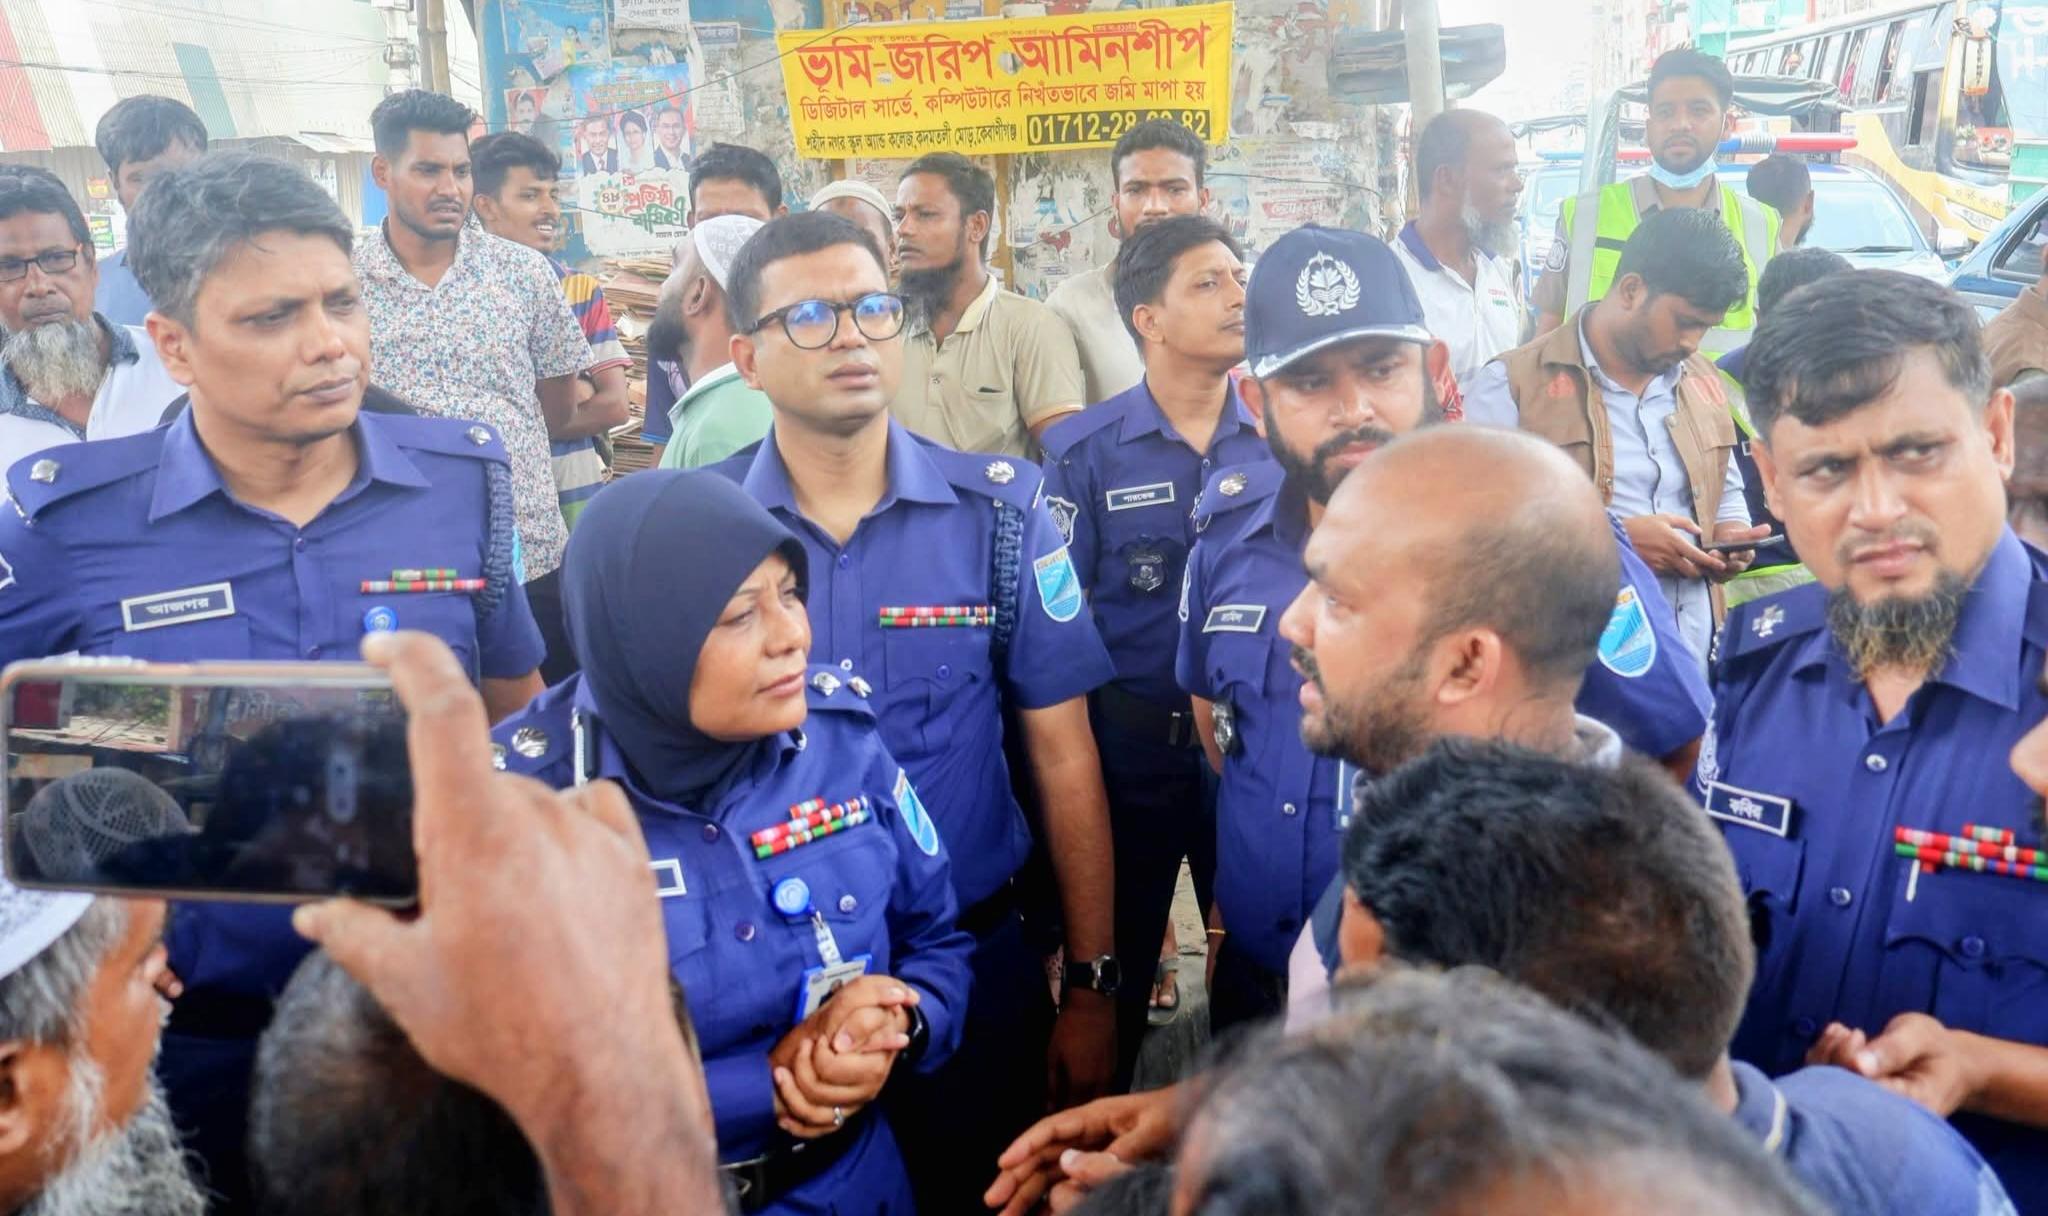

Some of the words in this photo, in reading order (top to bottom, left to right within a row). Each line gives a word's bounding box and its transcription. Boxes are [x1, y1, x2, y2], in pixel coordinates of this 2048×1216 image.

[1009, 19, 1211, 76] আমিনশীপ
[800, 96, 866, 121] ডিজিটাল
[923, 87, 1011, 112] কম্পিউটারে
[1104, 76, 1137, 101] জমি
[1142, 79, 1179, 101] মাপা
[1184, 81, 1206, 101] হয়
